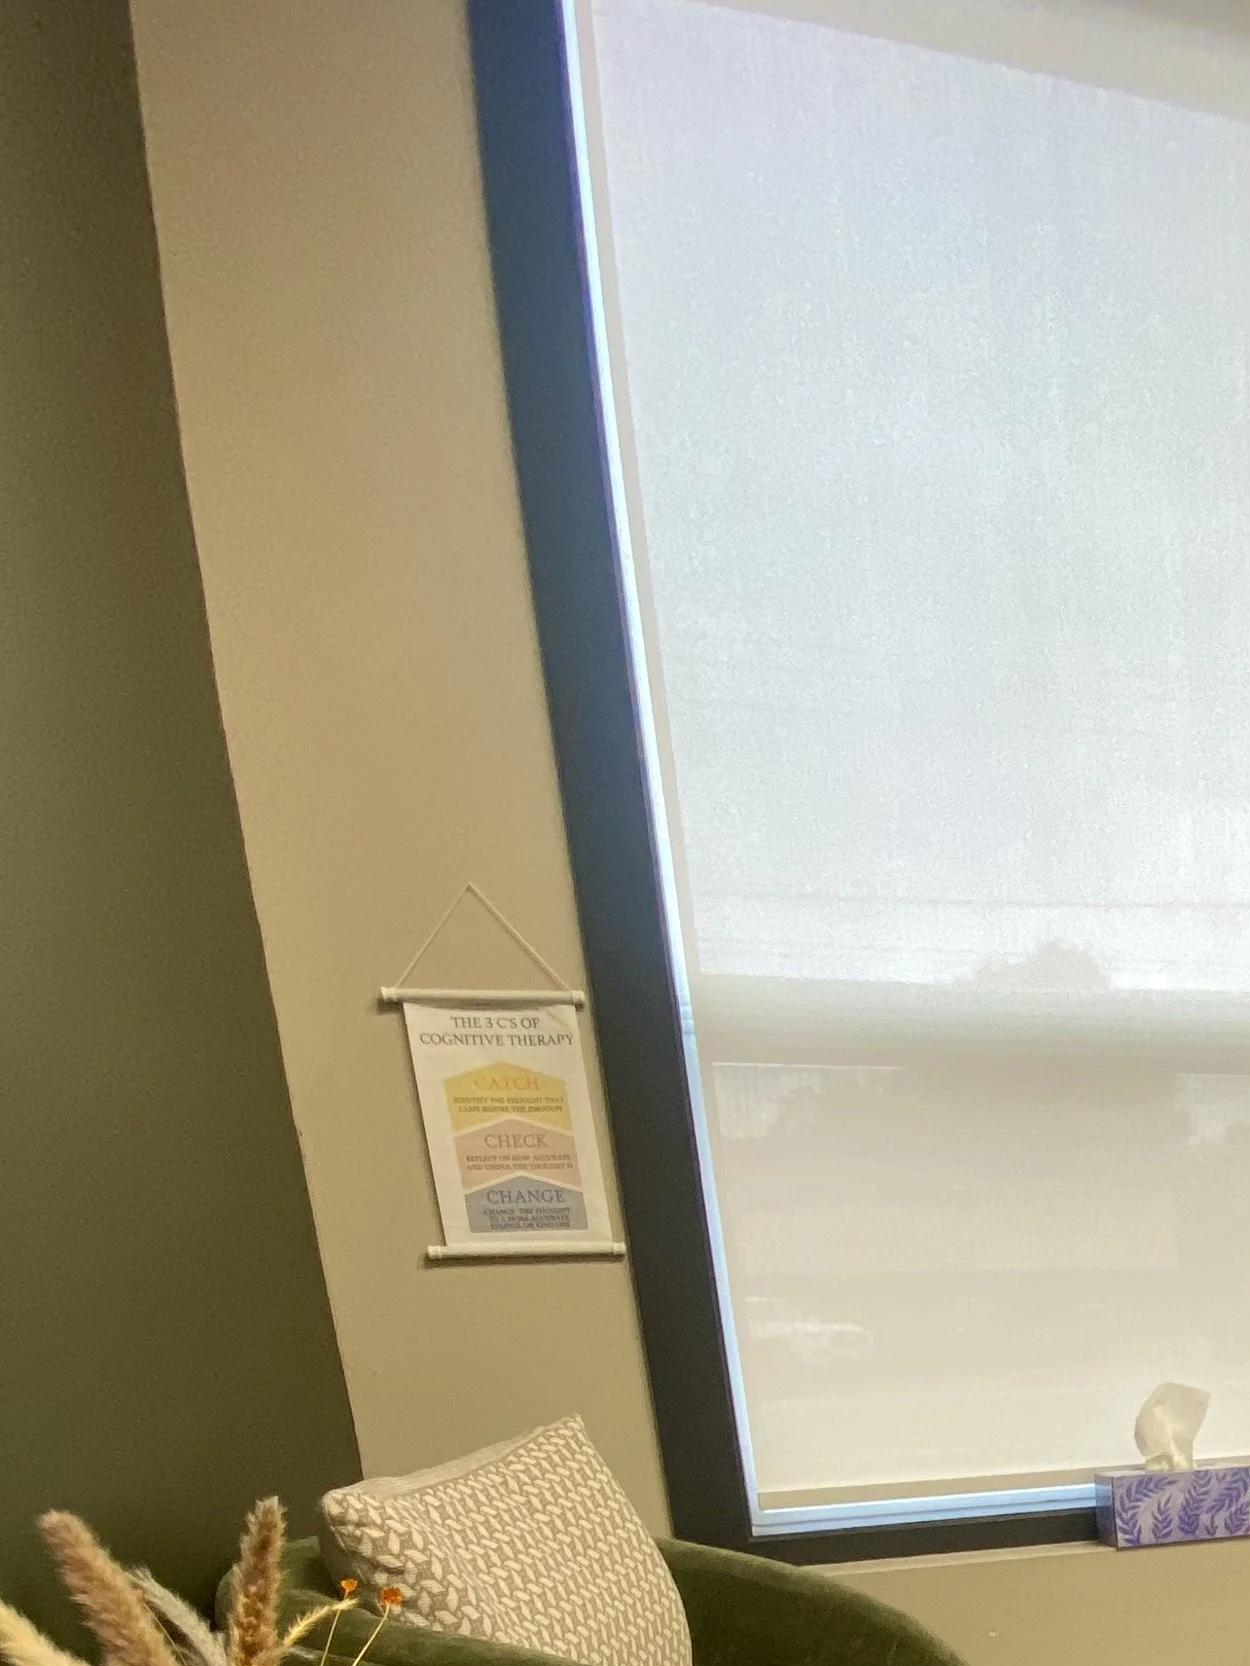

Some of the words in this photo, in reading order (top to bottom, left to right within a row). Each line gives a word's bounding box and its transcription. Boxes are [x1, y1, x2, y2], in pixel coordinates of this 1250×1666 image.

[451, 1016, 481, 1029] THE
[484, 1016, 493, 1029] 3
[520, 1016, 540, 1030] OF
[419, 1032, 504, 1047] COGNITIVE
[506, 1032, 575, 1047] THERAPY
[473, 1076, 540, 1092] CATCH
[484, 1133, 549, 1149] CHECK
[486, 1189, 567, 1205] CHANGE
